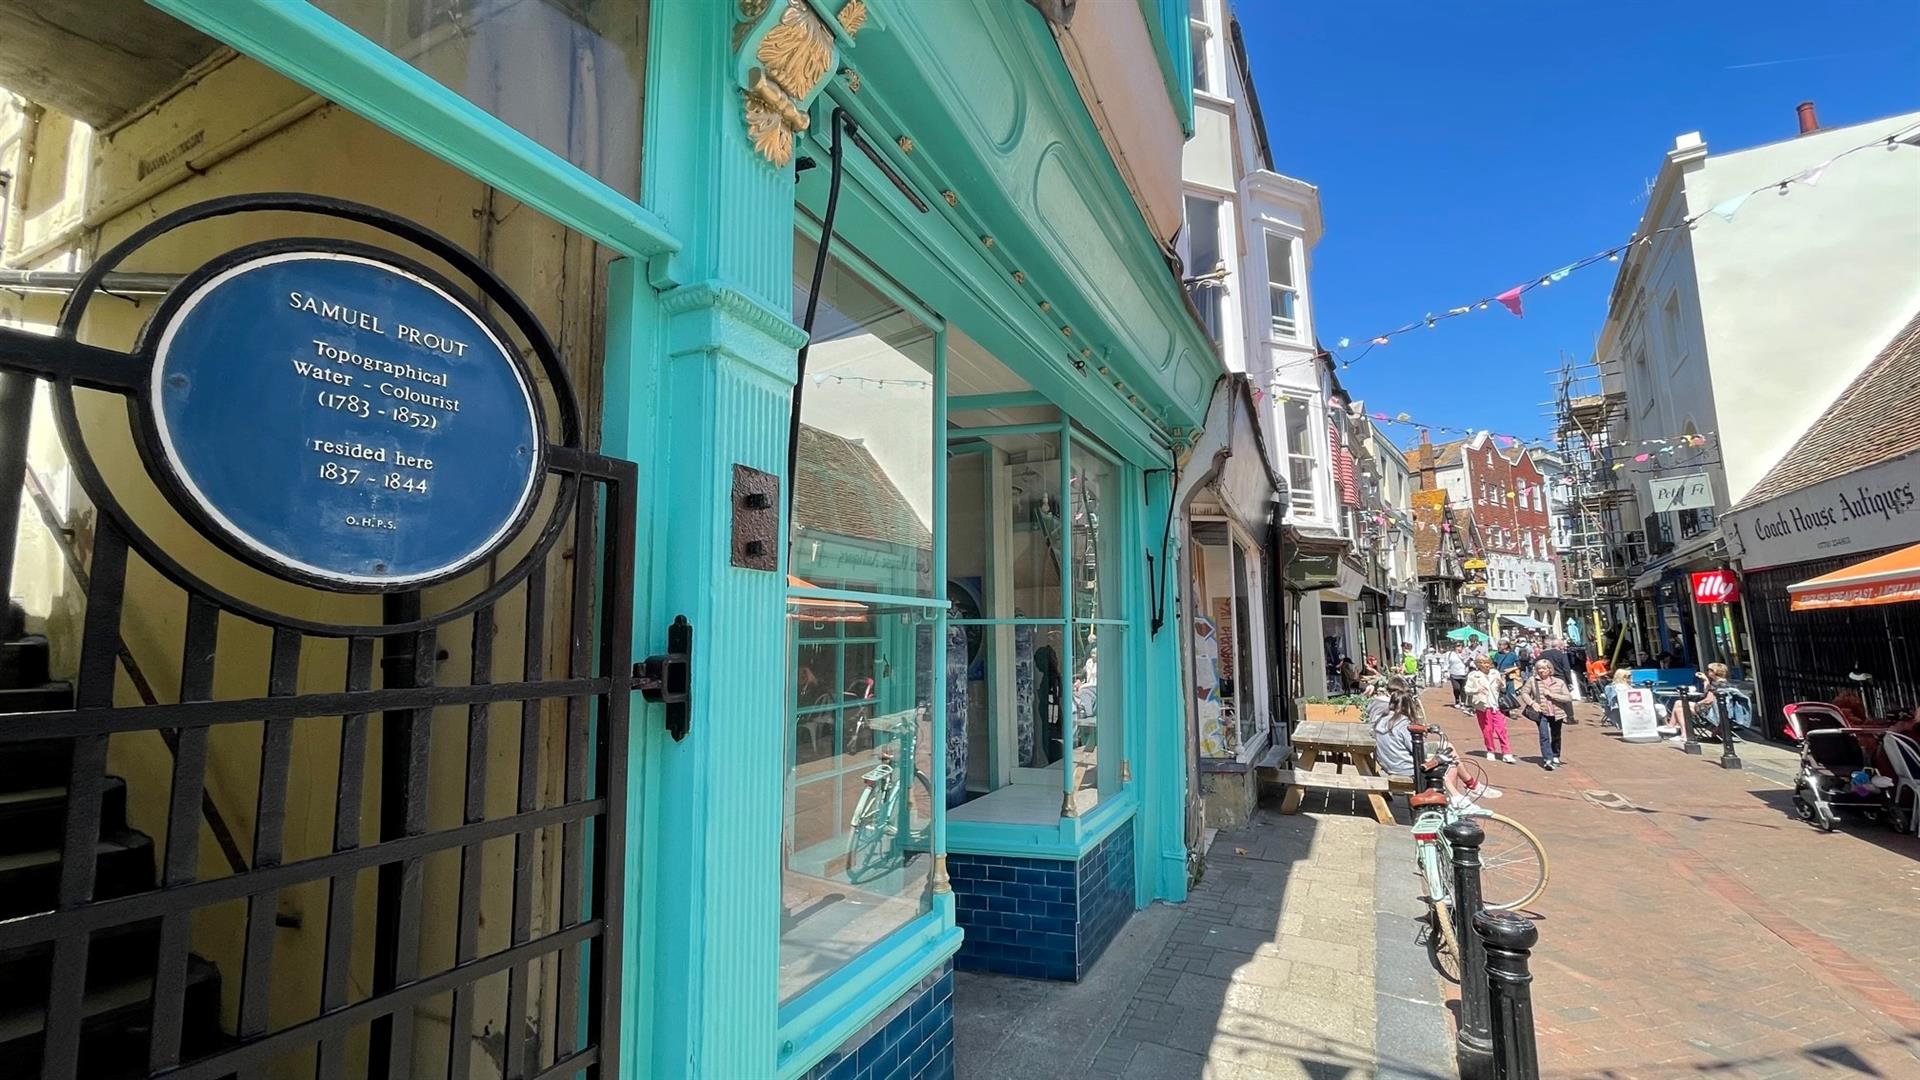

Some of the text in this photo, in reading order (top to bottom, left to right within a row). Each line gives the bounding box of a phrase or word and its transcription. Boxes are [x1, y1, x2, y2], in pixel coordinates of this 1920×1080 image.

[289, 291, 468, 357] SAMUEL PROUT
[312, 339, 447, 388] Topographical
[292, 359, 353, 387] Water
[379, 382, 460, 412] Colourist
[318, 391, 370, 418] (1783
[392, 406, 437, 430] 1852)
[313, 440, 433, 470] resided here
[320, 462, 361, 485] 1837
[384, 472, 428, 493] 1844
[345, 515, 397, 530] O.H.P.S.
[1754, 482, 1915, 541] Coach House Antiques
[1697, 575, 1734, 601] illy
